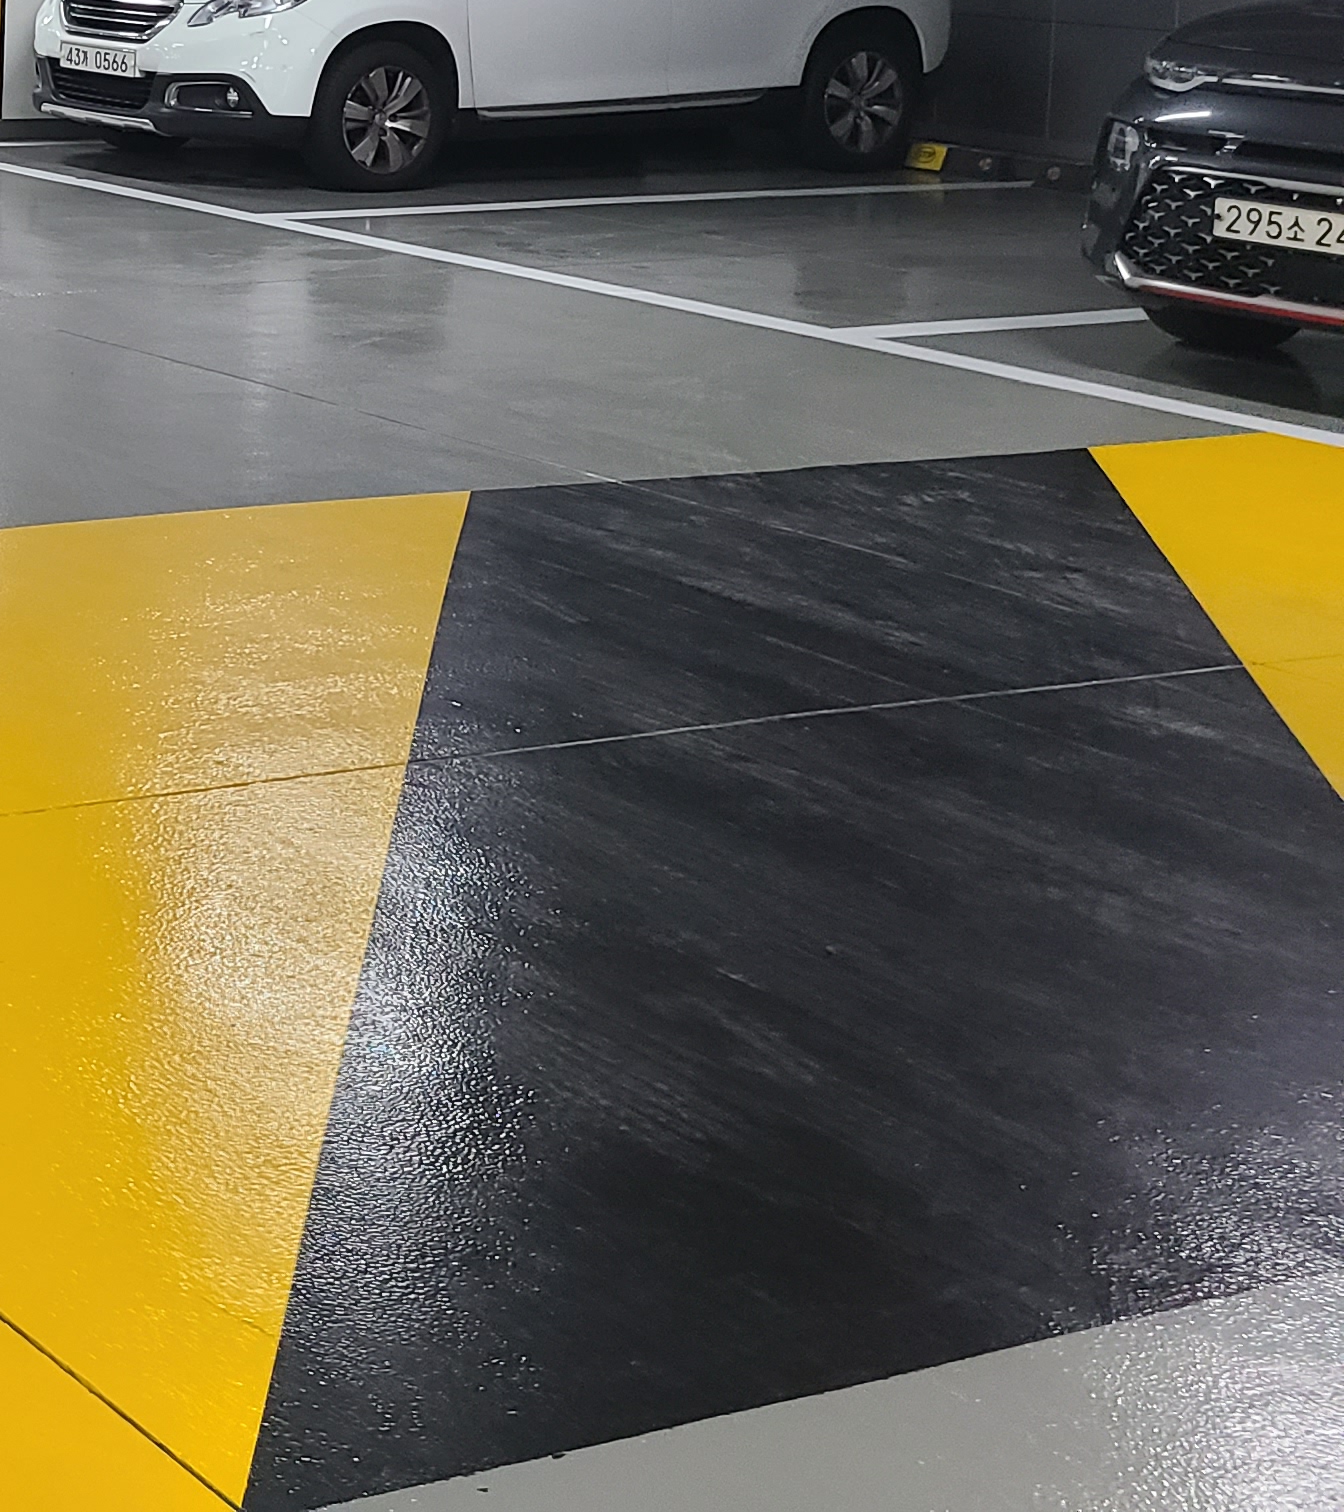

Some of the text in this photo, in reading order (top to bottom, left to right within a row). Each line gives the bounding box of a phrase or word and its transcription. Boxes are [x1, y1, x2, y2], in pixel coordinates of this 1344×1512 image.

[66, 46, 128, 73] 43가 0566
[1225, 205, 1305, 242] 295소
